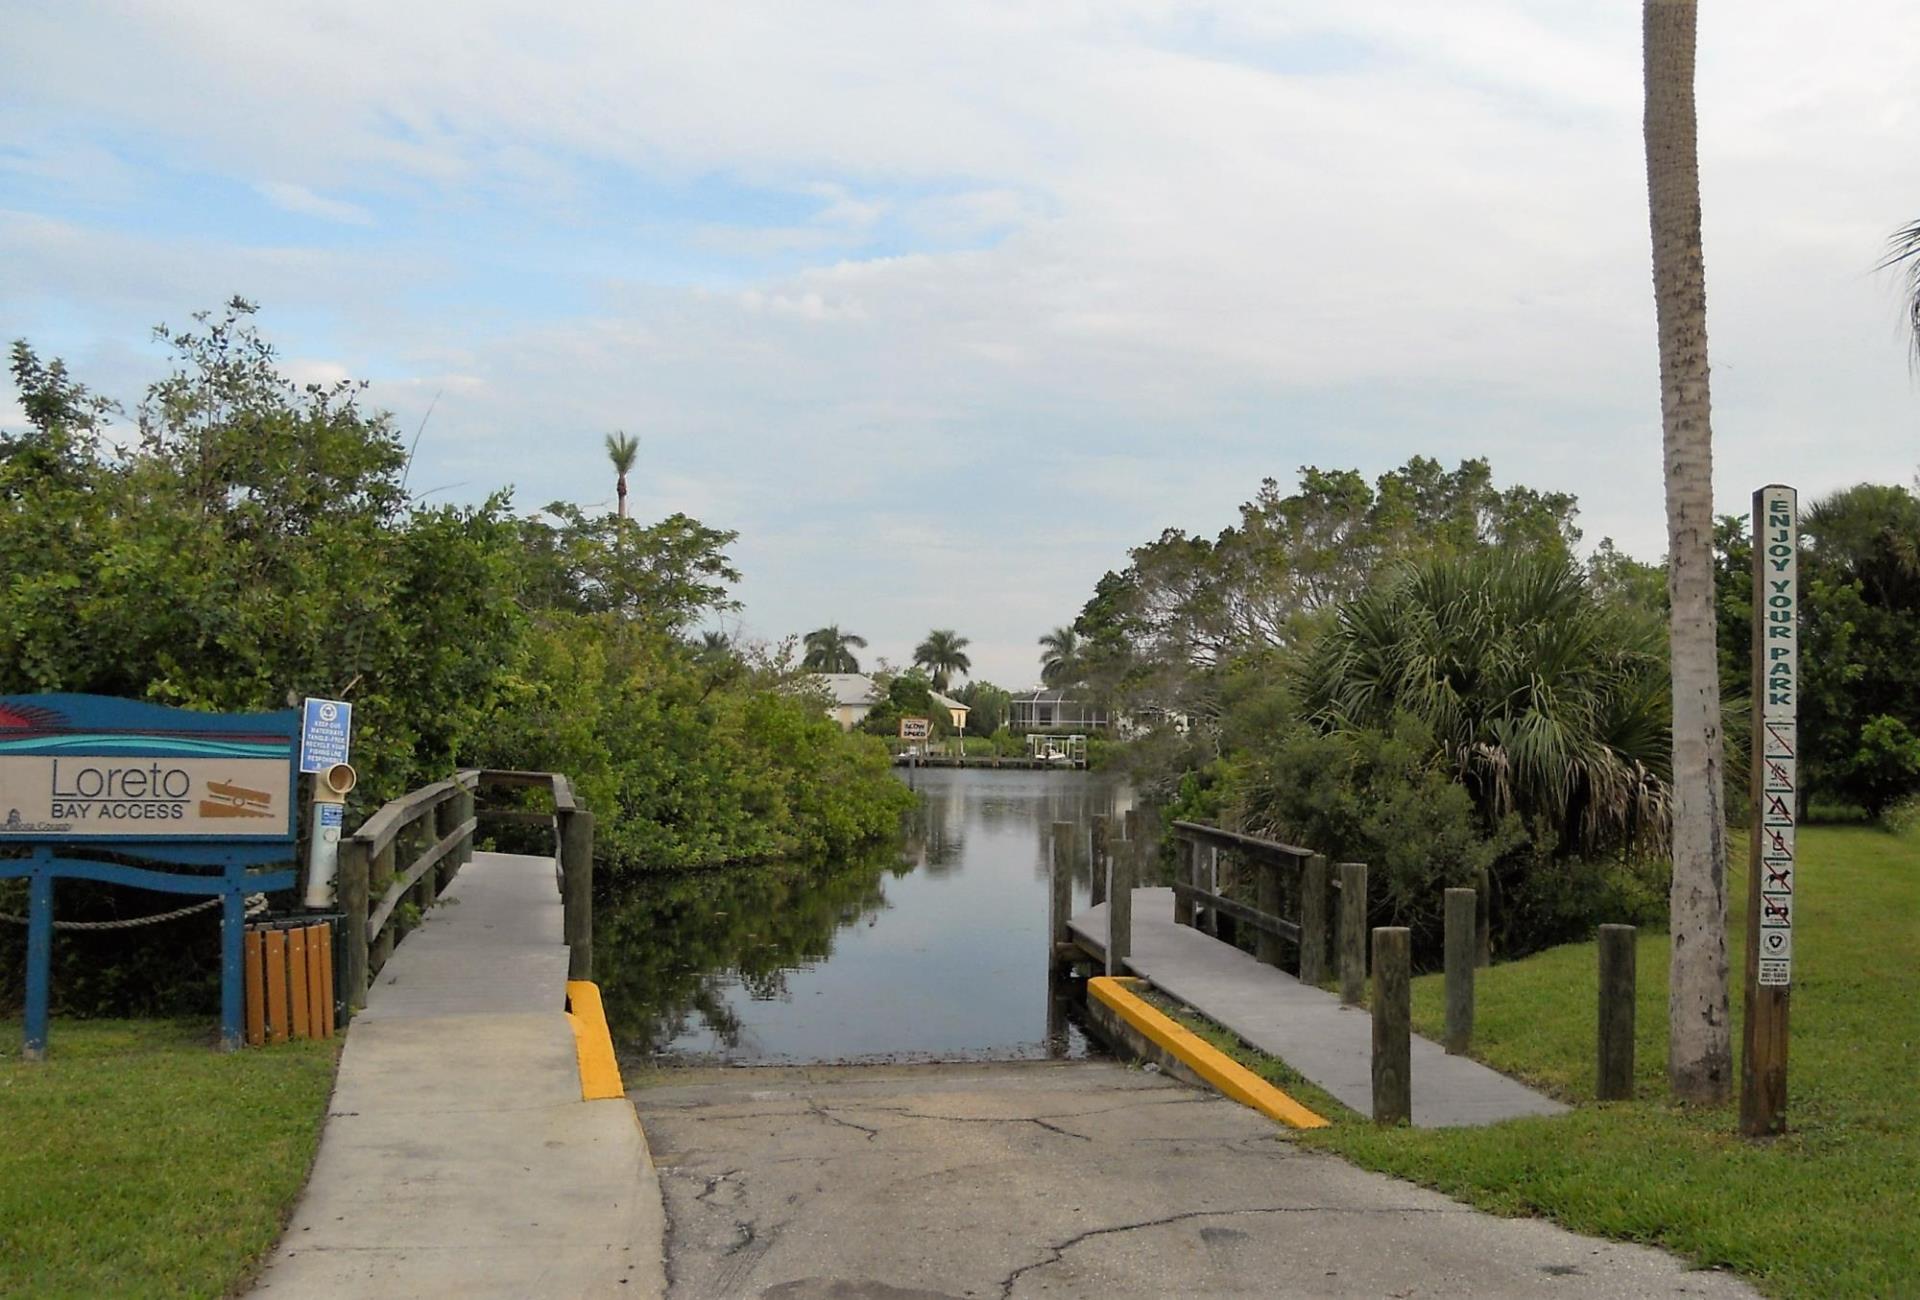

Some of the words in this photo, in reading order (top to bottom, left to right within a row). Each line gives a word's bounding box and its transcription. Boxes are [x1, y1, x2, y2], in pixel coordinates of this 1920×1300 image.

[1768, 500, 1791, 571] ENJOY
[1768, 580, 1791, 639] YOUR
[1768, 647, 1791, 706] PARK
[52, 759, 190, 798] Loreto
[52, 804, 91, 818] BAY
[98, 803, 183, 819] ACCESS
